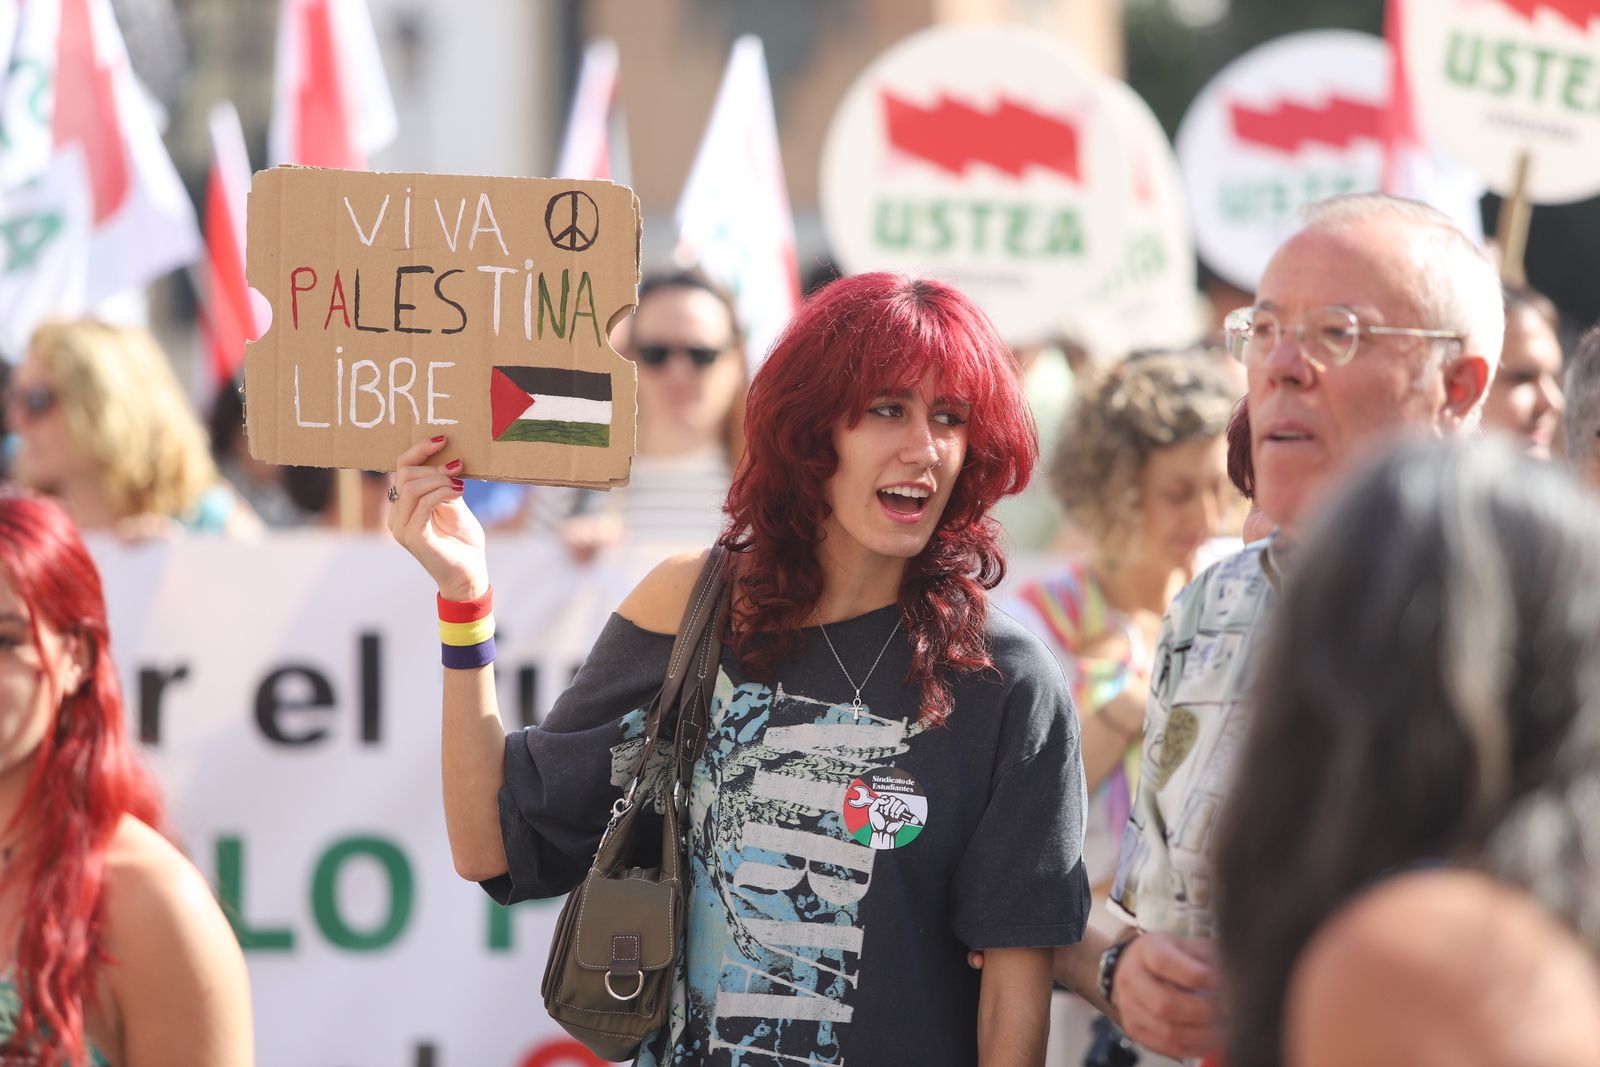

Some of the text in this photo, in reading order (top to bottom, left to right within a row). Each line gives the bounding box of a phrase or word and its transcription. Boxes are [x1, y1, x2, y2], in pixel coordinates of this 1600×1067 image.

[1443, 30, 1600, 112] USTE
[873, 199, 1085, 257] USTEA
[253, 632, 384, 746] el
[872, 775, 905, 784] Sindicato
[872, 783, 914, 792] Estudiantes
[708, 681, 909, 1067] NIRVA
